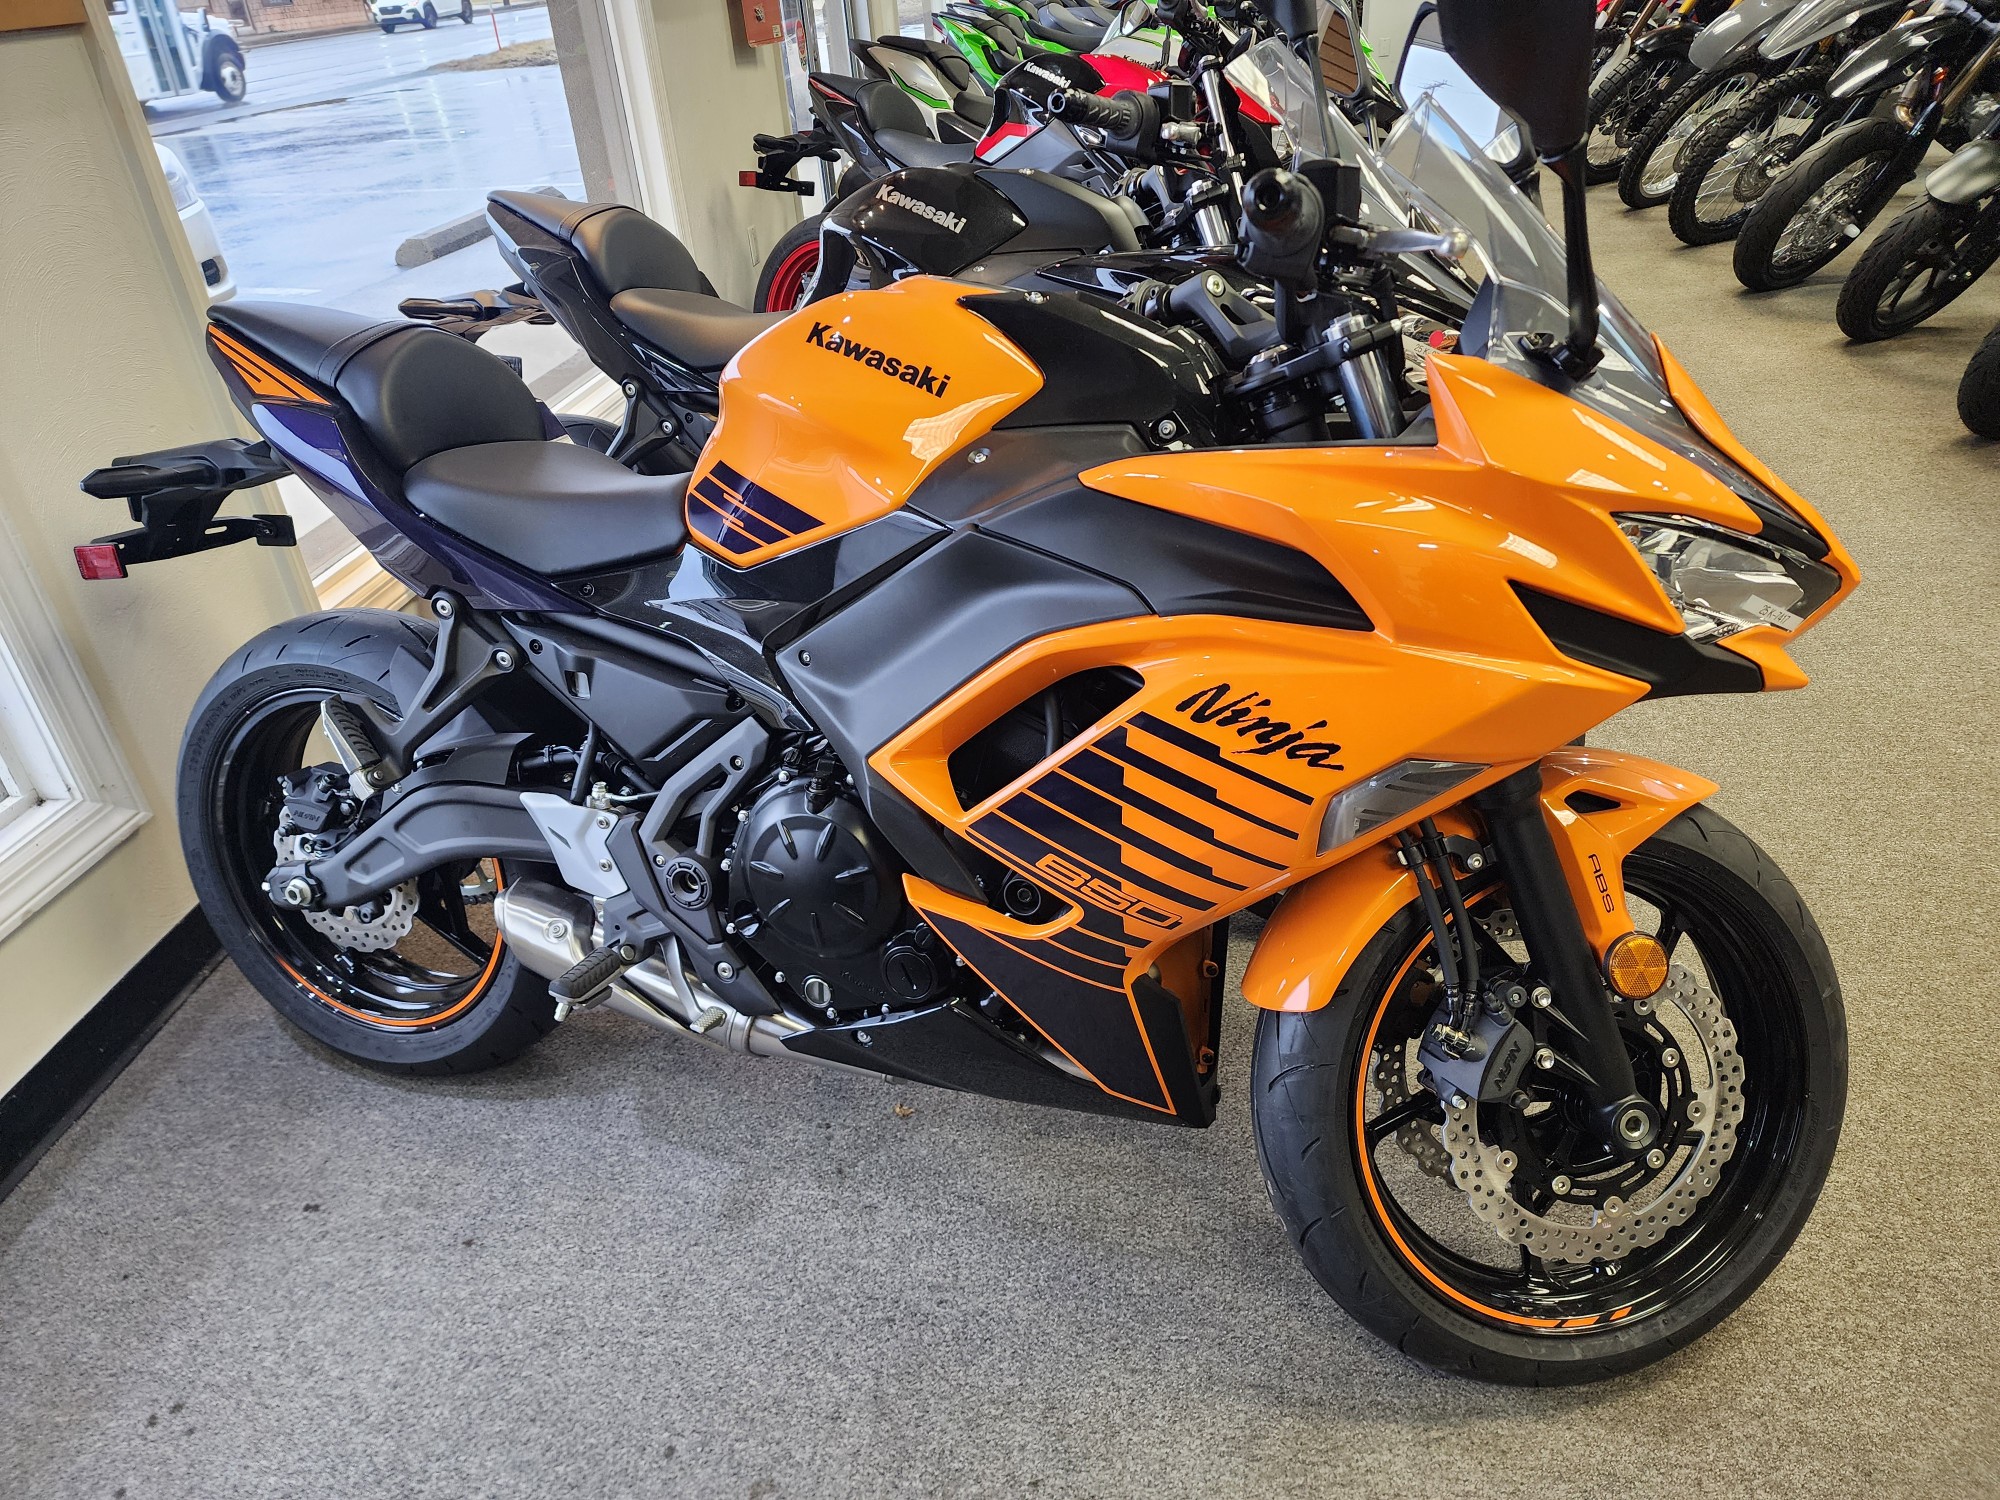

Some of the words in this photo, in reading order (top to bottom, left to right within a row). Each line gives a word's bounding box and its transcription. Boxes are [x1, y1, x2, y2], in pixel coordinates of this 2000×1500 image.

[1023, 61, 1072, 89] Kawasaki
[875, 183, 967, 234] Kawasaki
[806, 321, 951, 399] Kawasaki
[1175, 683, 1345, 771] Ninja
[1035, 853, 1183, 929] 650
[1588, 853, 1615, 913] ABS
